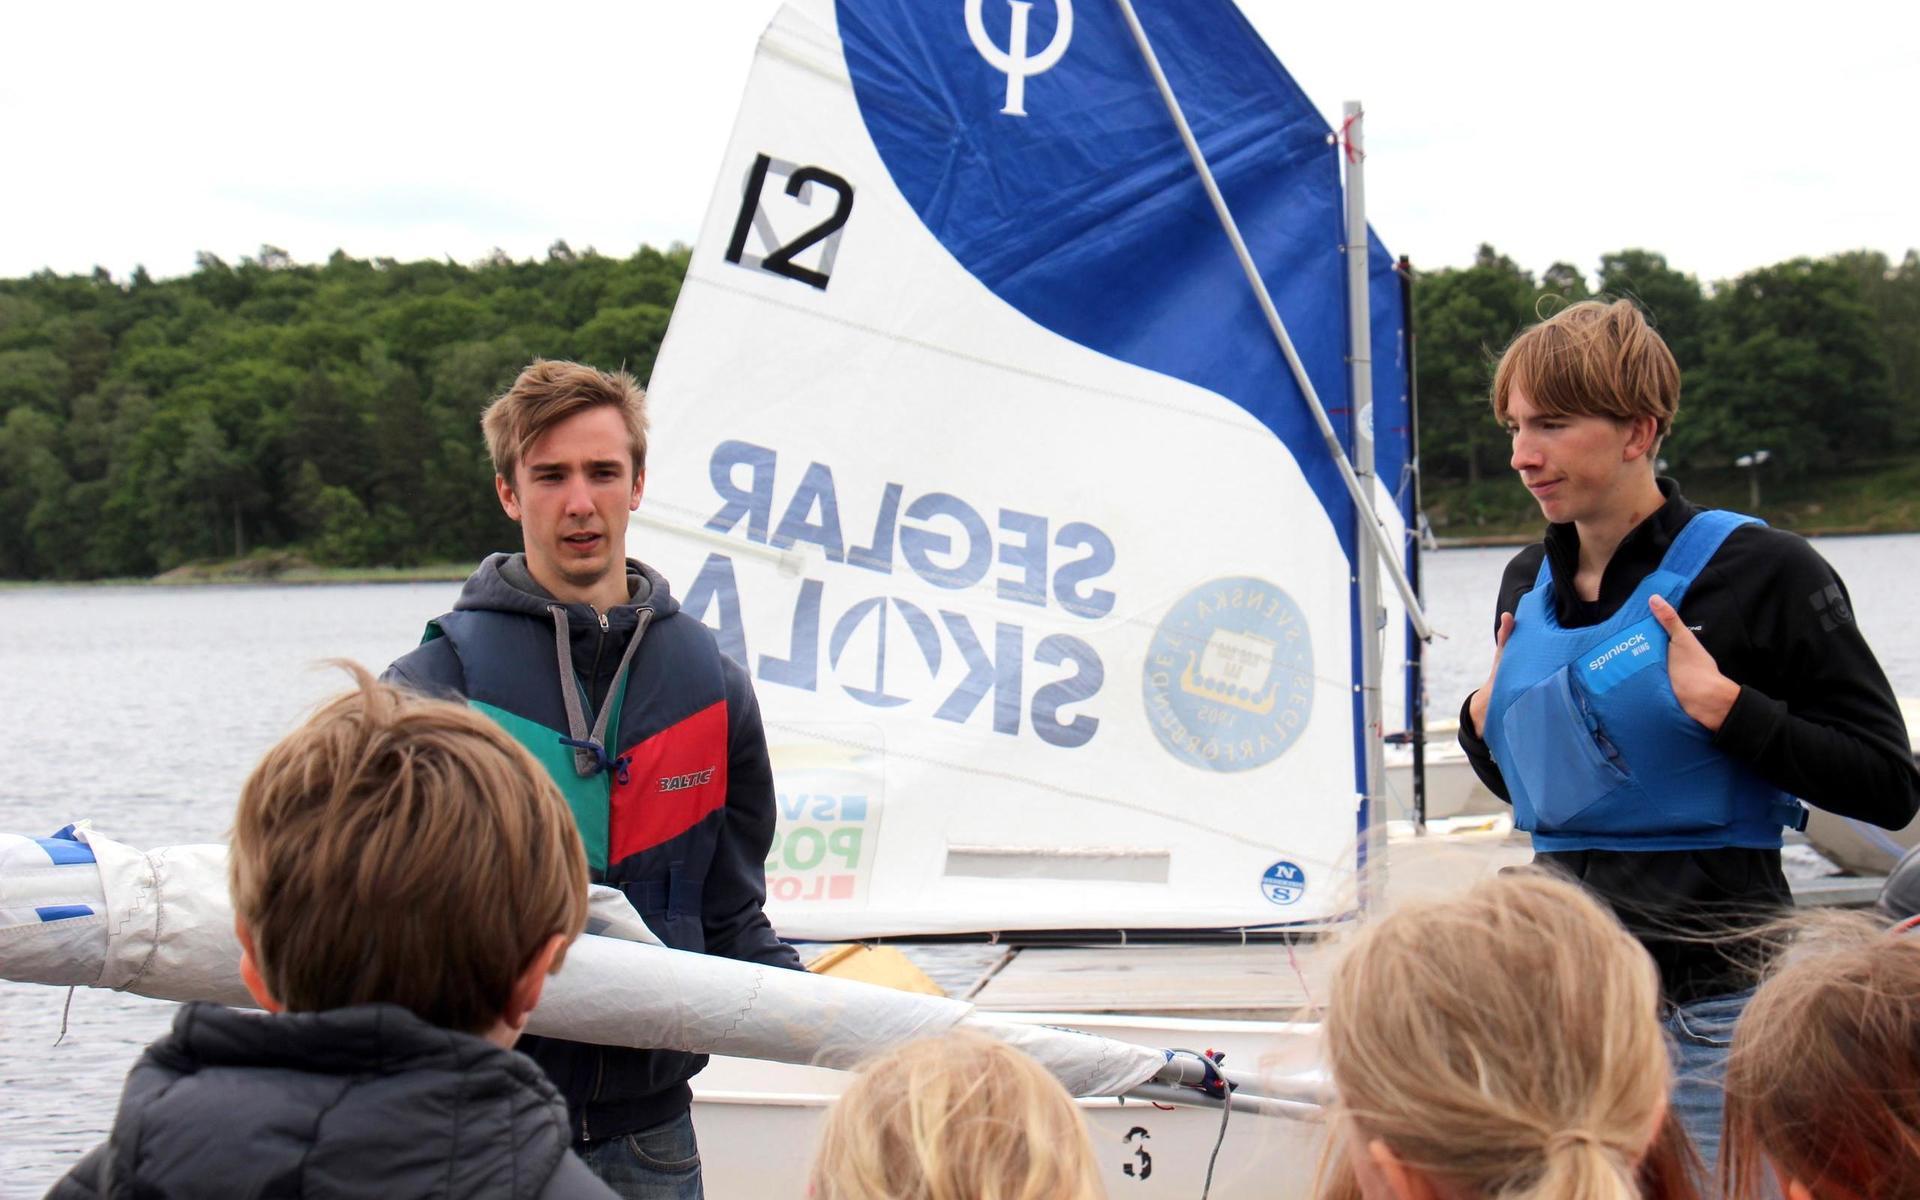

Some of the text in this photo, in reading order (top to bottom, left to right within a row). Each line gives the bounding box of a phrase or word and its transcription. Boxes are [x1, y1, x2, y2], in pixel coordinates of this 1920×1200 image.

[724, 151, 854, 292] 12
[1588, 632, 1647, 671] spinlock
[657, 767, 713, 791] BALTIC
[1275, 866, 1297, 879] N
[1272, 887, 1291, 900] S
[1123, 1126, 1151, 1180] 3
